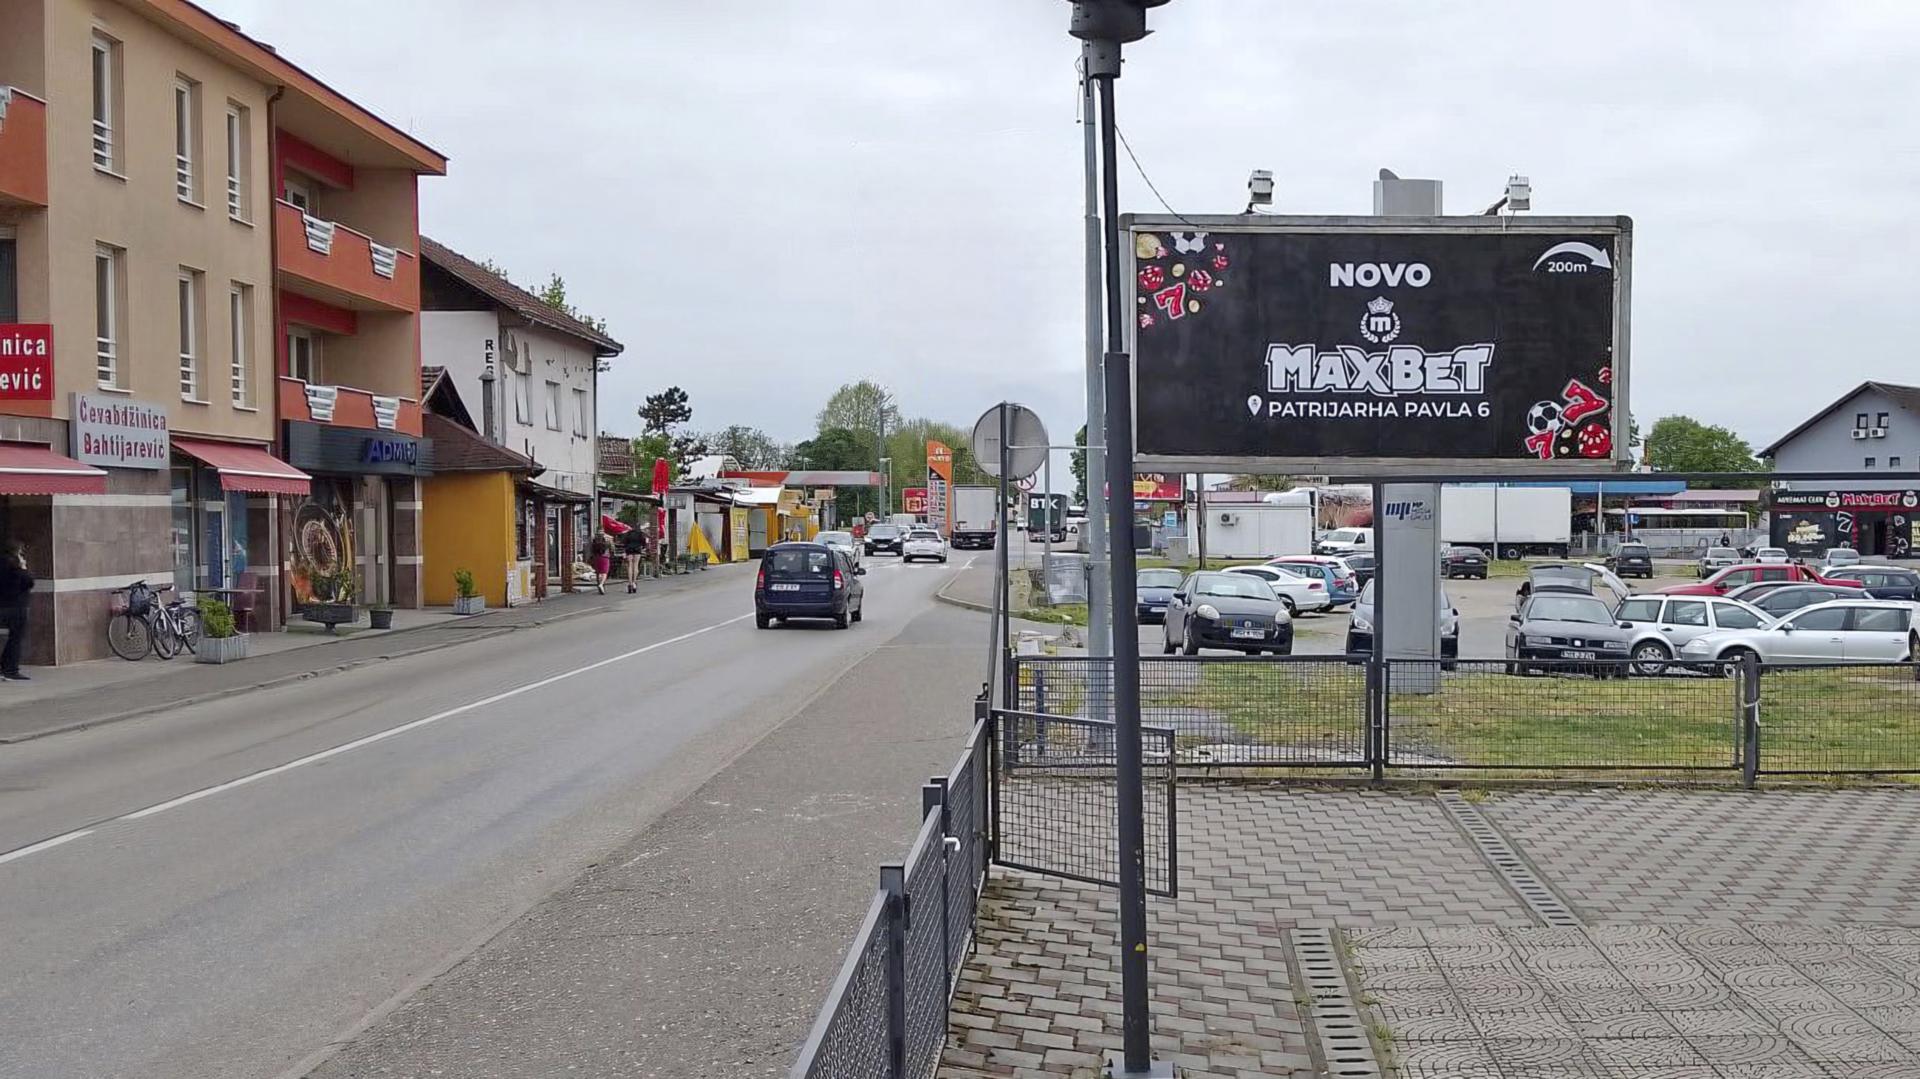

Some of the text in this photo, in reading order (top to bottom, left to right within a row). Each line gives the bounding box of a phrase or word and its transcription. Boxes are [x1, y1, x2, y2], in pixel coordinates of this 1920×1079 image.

[1330, 262, 1431, 288] NOVO
[1547, 261, 1588, 273] 200m
[1268, 401, 1490, 418] PATRIJARHA PAVLA 6
